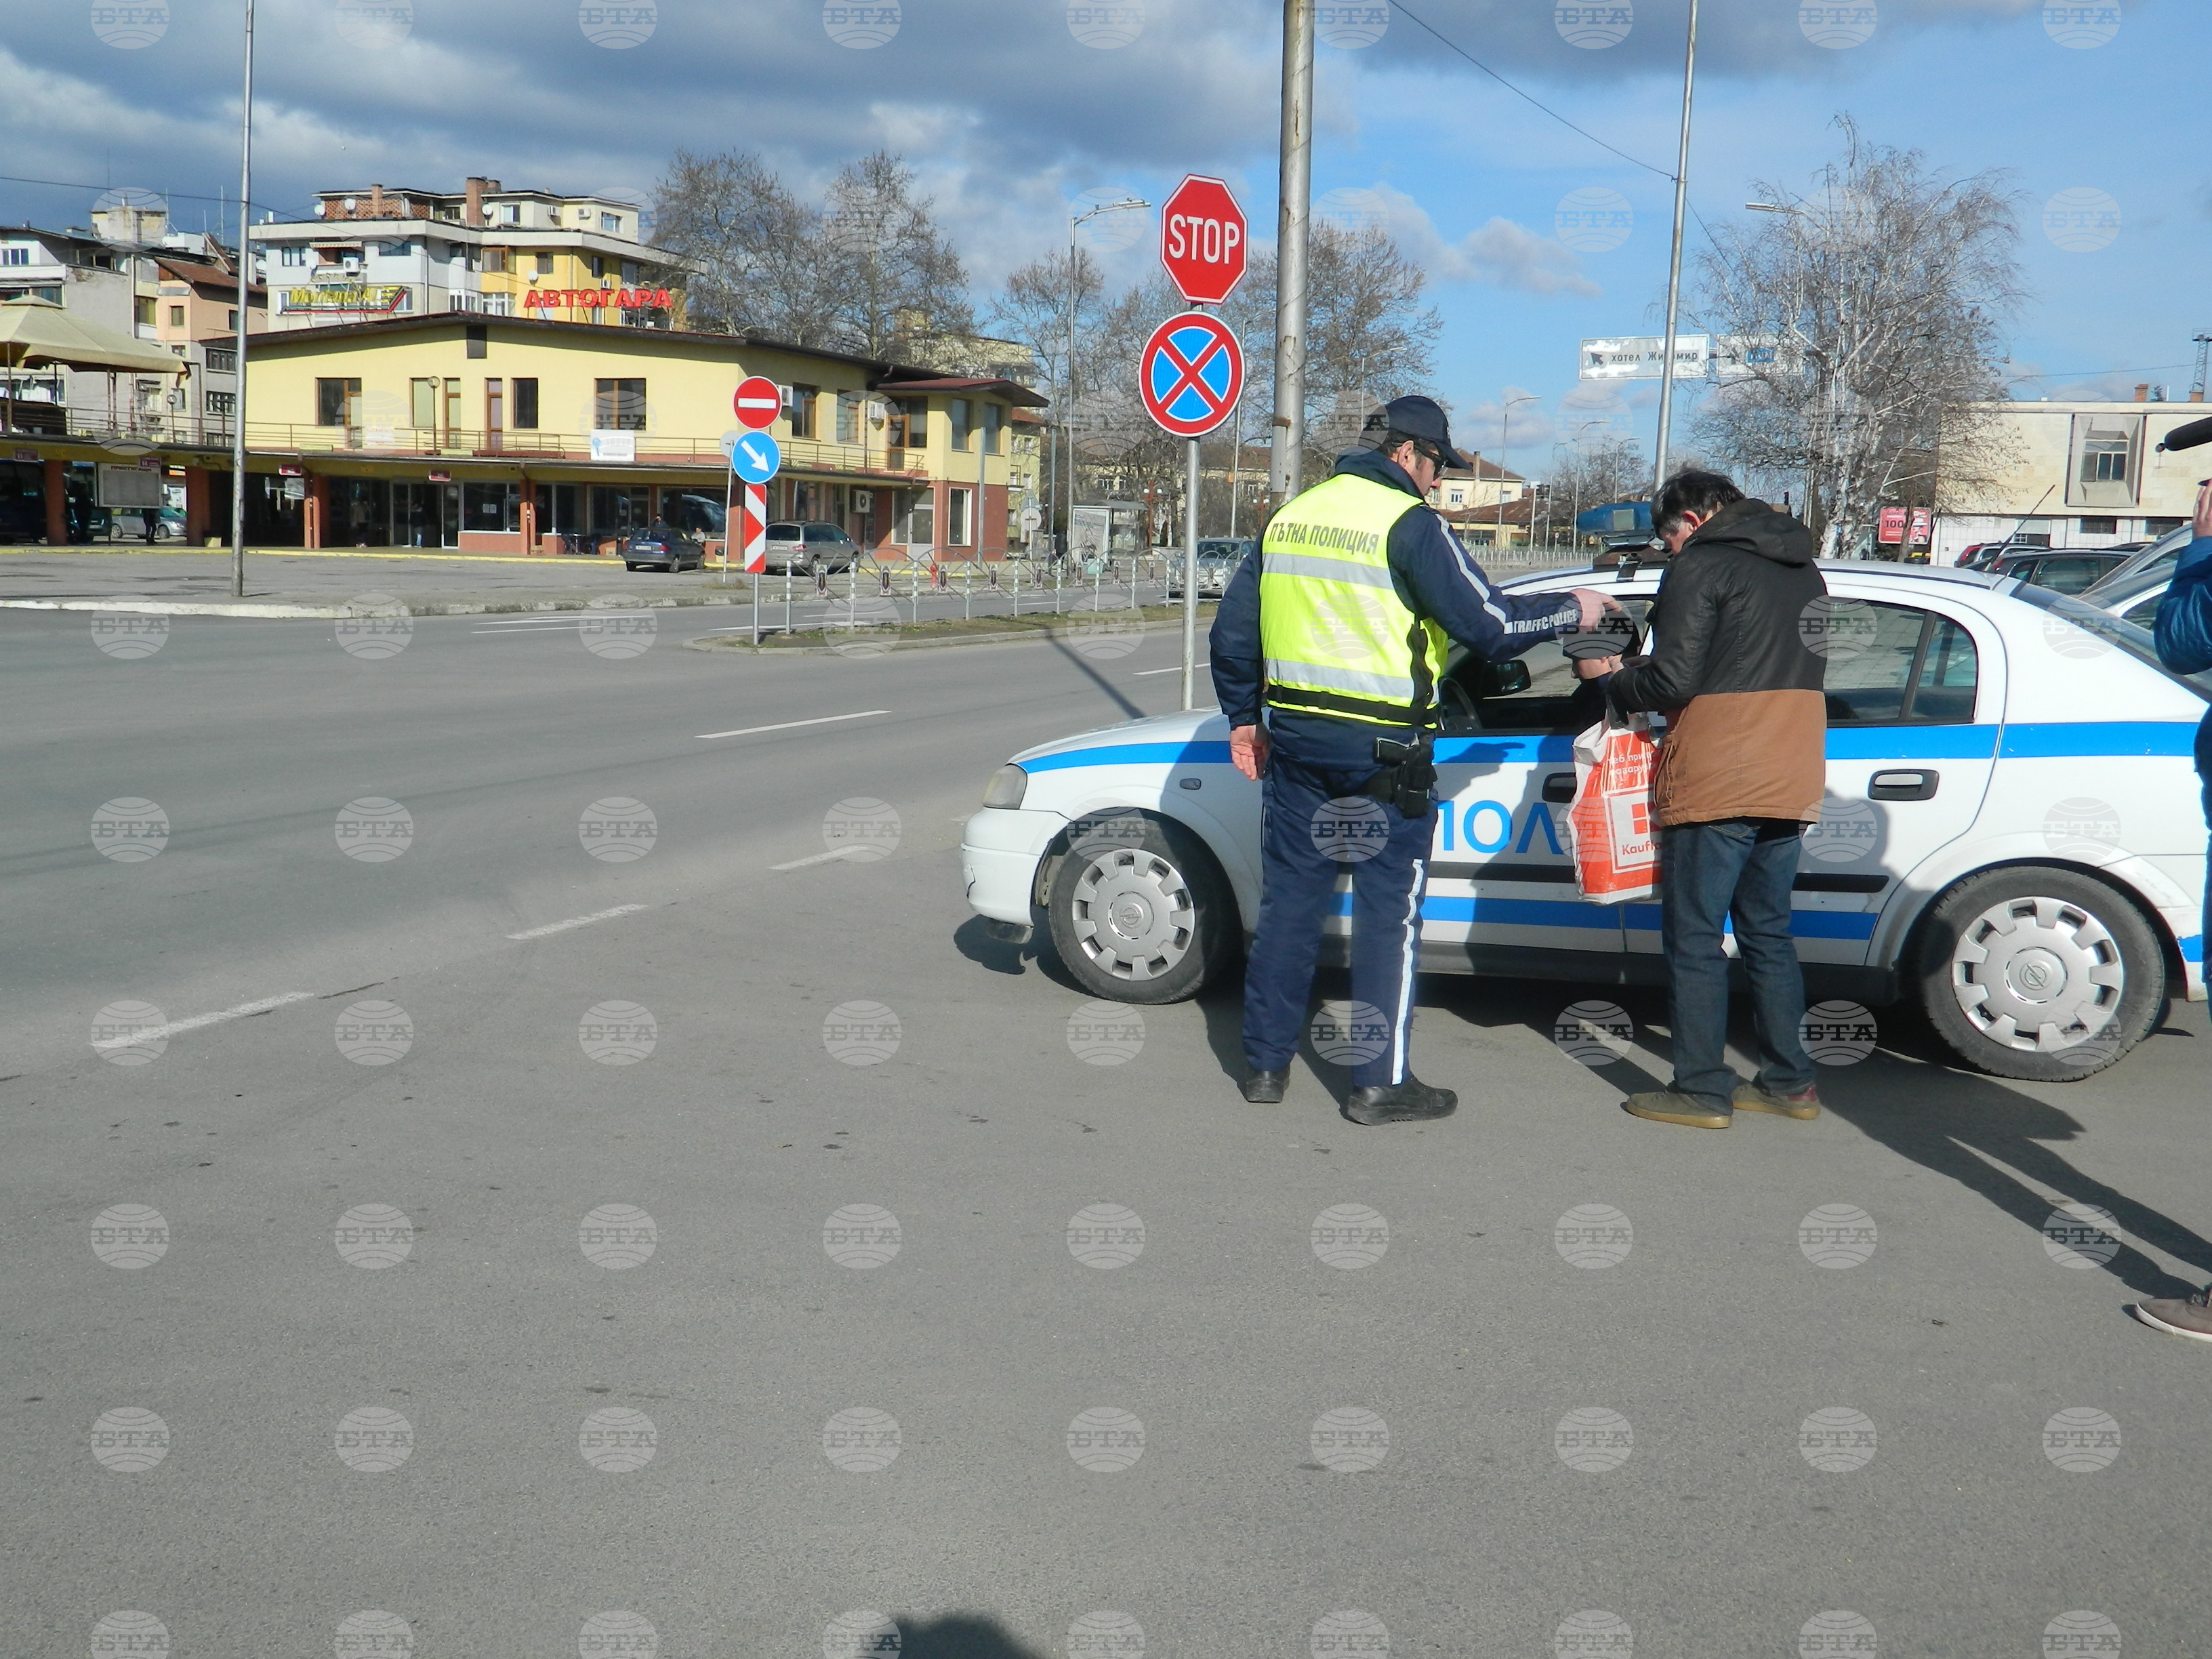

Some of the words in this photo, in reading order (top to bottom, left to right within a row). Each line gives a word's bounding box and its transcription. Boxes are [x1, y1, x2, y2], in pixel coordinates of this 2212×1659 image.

[1168, 213, 1240, 264] STOP
[523, 288, 672, 308] АВТОГАРА
[1611, 353, 1641, 363] хотел
[1647, 351, 1698, 362] Жимир
[1885, 520, 1904, 528] 100
[1268, 523, 1308, 544] ПЪТНА
[1309, 525, 1380, 555] ПОЛИЦИЯ
[1513, 617, 1549, 634] TRAFFC
[1549, 609, 1578, 628] POLICE
